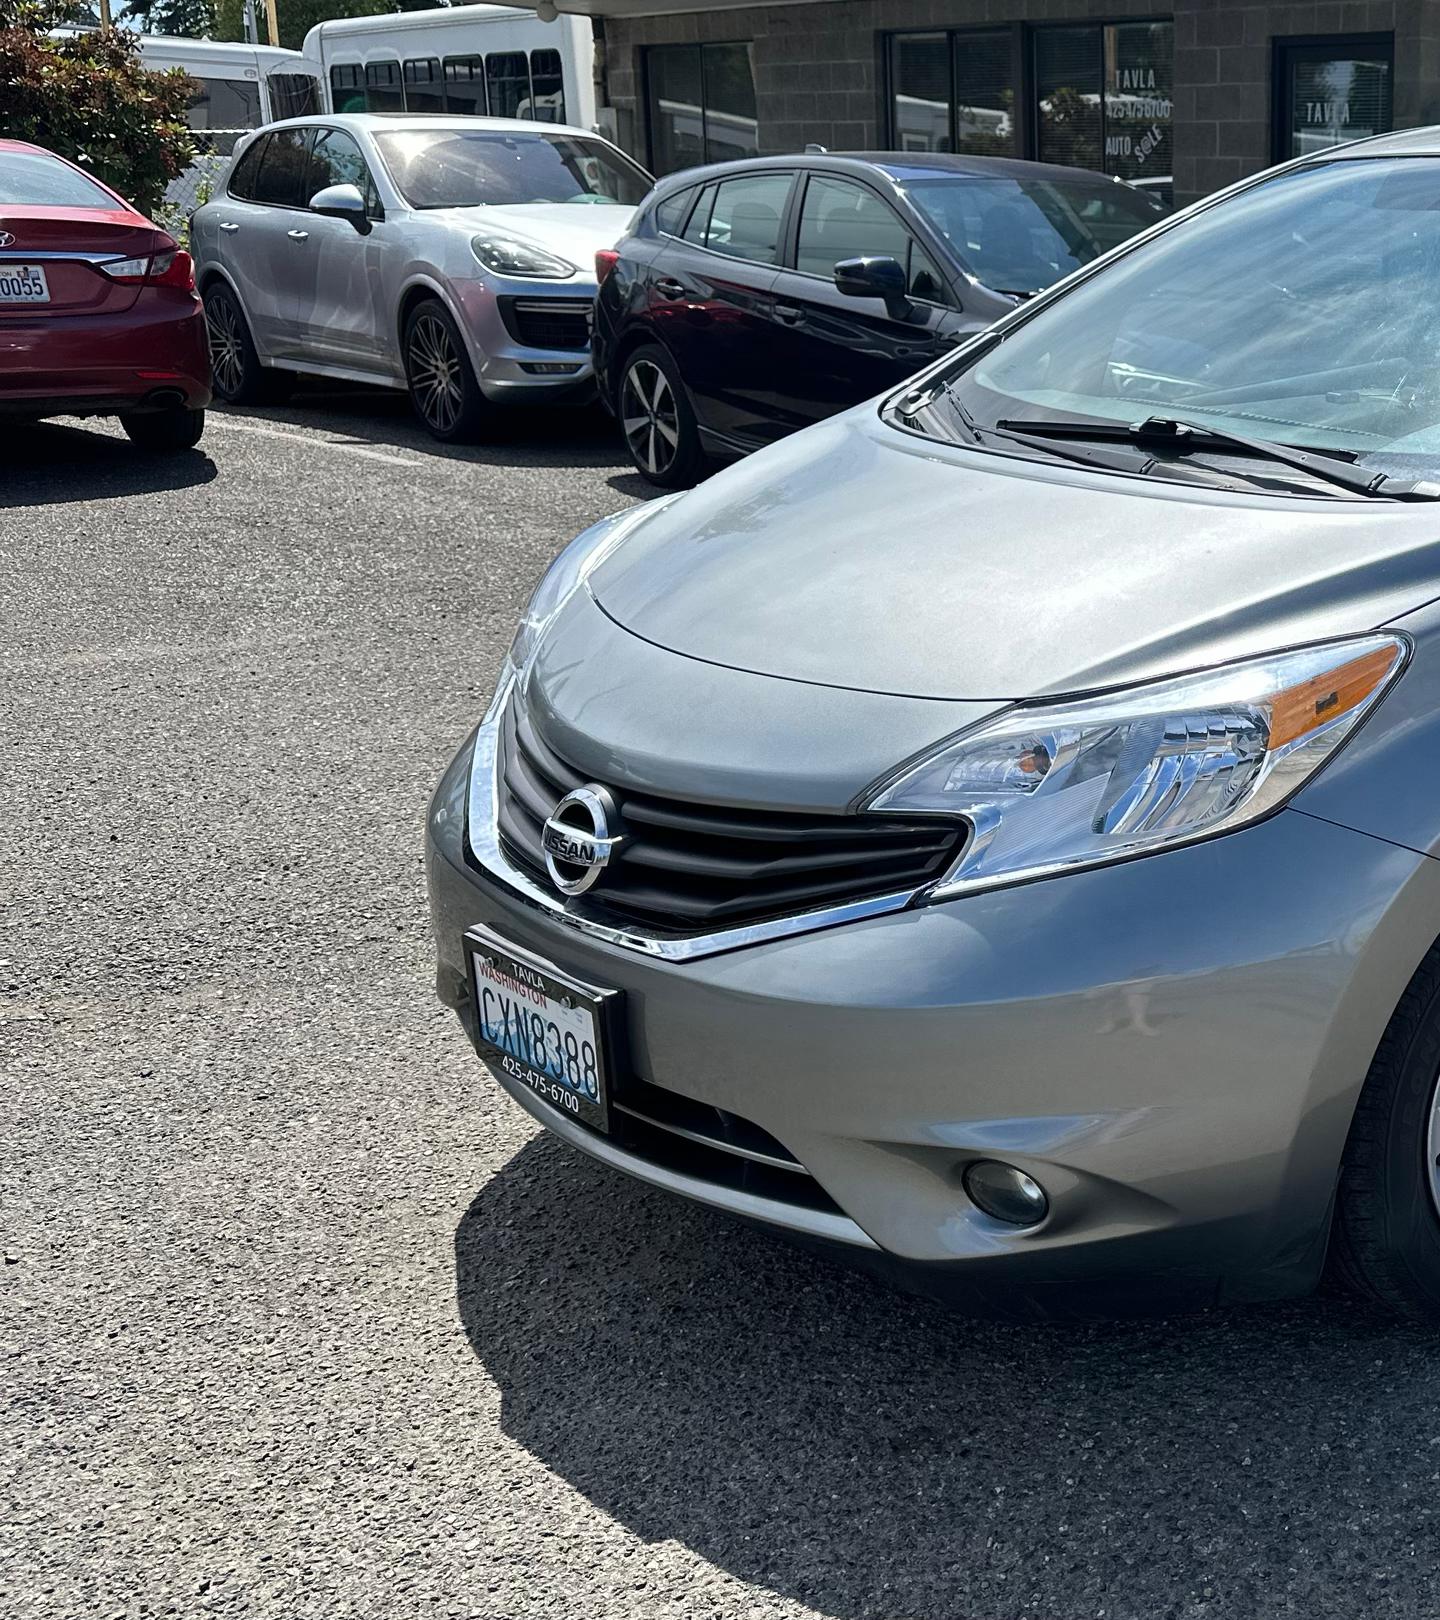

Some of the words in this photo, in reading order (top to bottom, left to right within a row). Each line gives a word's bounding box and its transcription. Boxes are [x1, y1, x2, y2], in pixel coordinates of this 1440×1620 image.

[1116, 70, 1155, 88] TAVLA
[1105, 136, 1131, 155] AUTO
[478, 960, 548, 1009] WASHINGTON
[511, 963, 545, 991] TAVLA
[482, 987, 598, 1099] CXN8388
[502, 1055, 579, 1112] 425-475-6700
